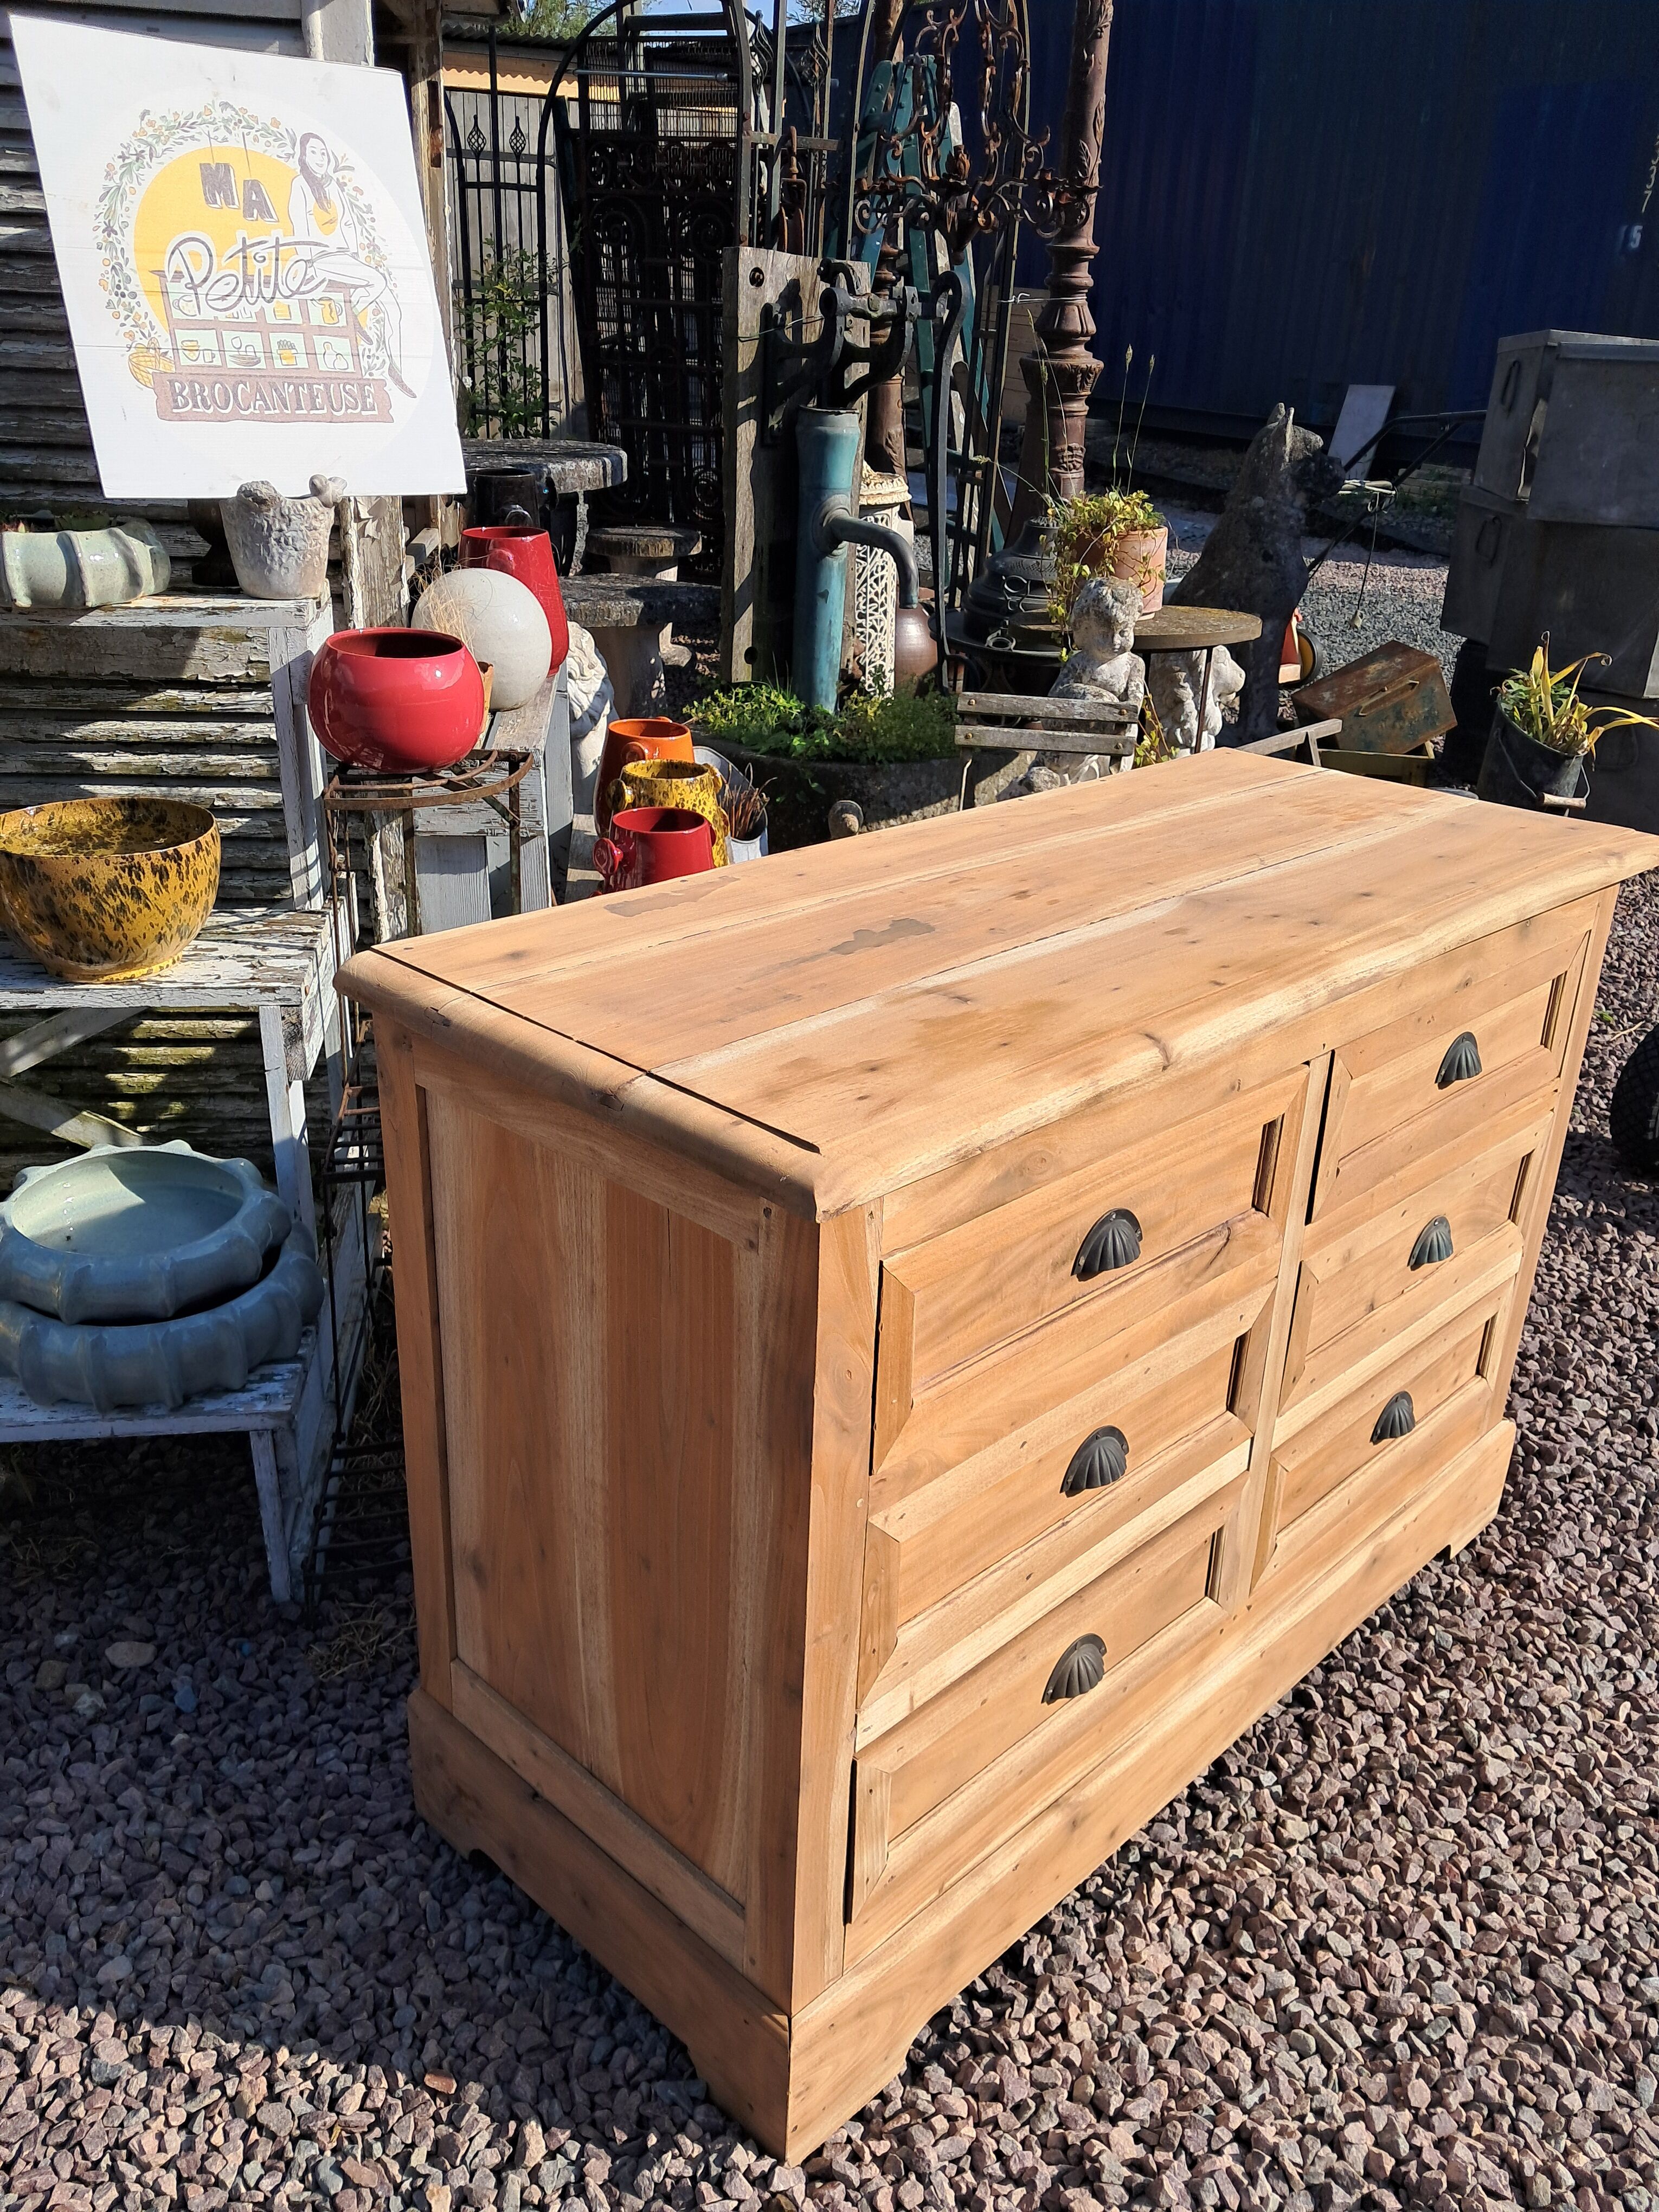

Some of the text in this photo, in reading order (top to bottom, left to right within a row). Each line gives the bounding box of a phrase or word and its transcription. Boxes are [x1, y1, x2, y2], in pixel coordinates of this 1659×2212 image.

[200, 163, 279, 223] MA
[168, 236, 329, 316] Petite
[167, 379, 378, 416] BROCANTEUSE
